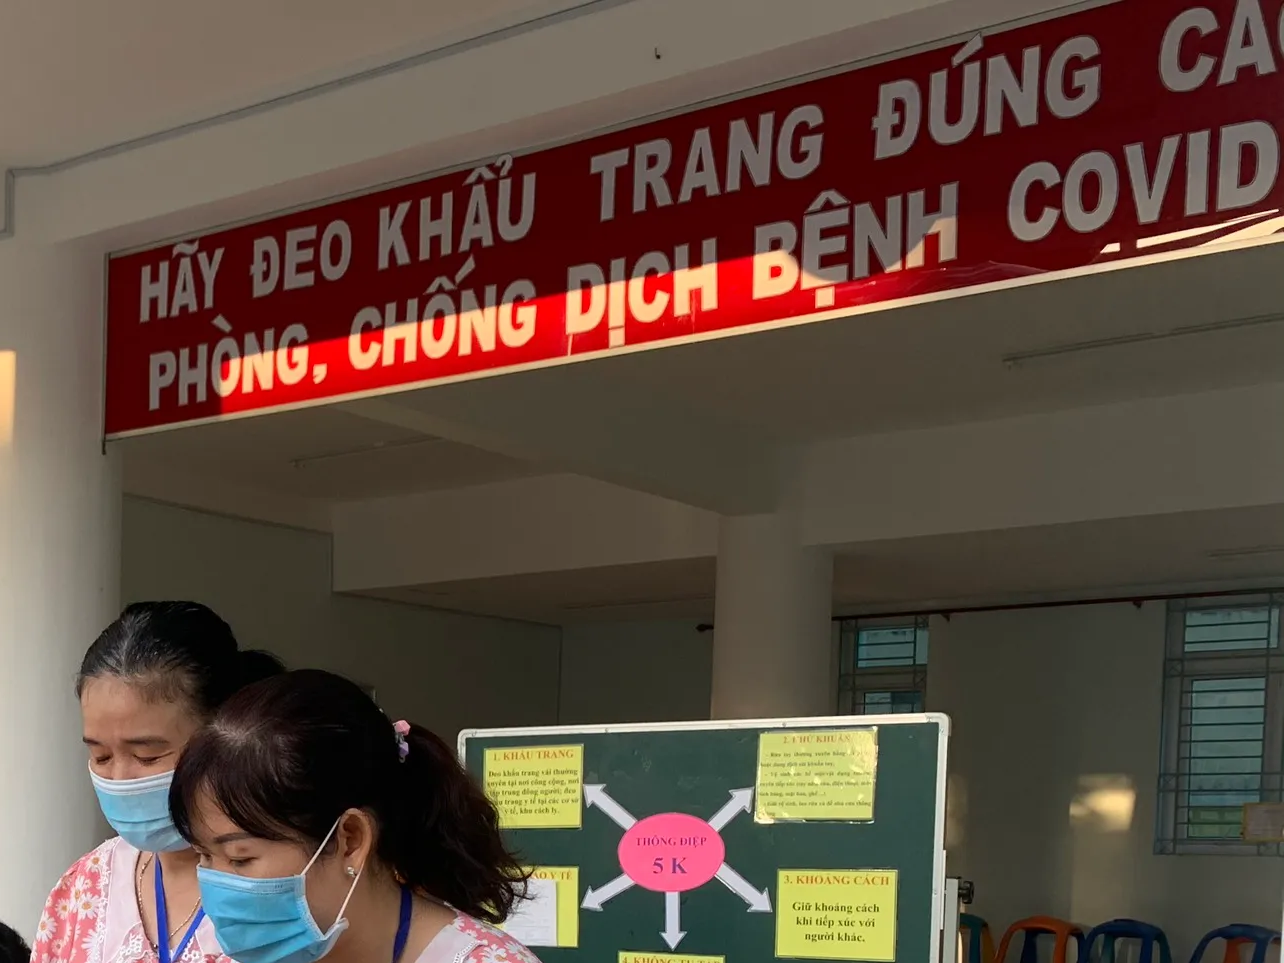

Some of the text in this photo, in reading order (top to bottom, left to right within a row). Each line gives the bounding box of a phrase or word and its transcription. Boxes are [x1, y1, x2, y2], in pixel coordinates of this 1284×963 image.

[140, 238, 224, 323] HÃY
[250, 219, 352, 299] ĐEO
[378, 154, 537, 271] KHẨU
[590, 104, 824, 222] TRANG
[872, 32, 1101, 160] ĐÚNG
[148, 120, 1281, 412] PHÒNG, CHỐNG DỊCH BỆNH COVID
[537, 749, 574, 760] TRANG
[636, 835, 707, 848] THÔNG ĐIỆP
[653, 857, 687, 874] 5 K
[854, 874, 889, 885] CÁCH
[792, 902, 812, 911] Giữ
[856, 903, 880, 913] cách
[796, 914, 875, 928] khi tiếp xúc với
[805, 932, 865, 942] người khác.
